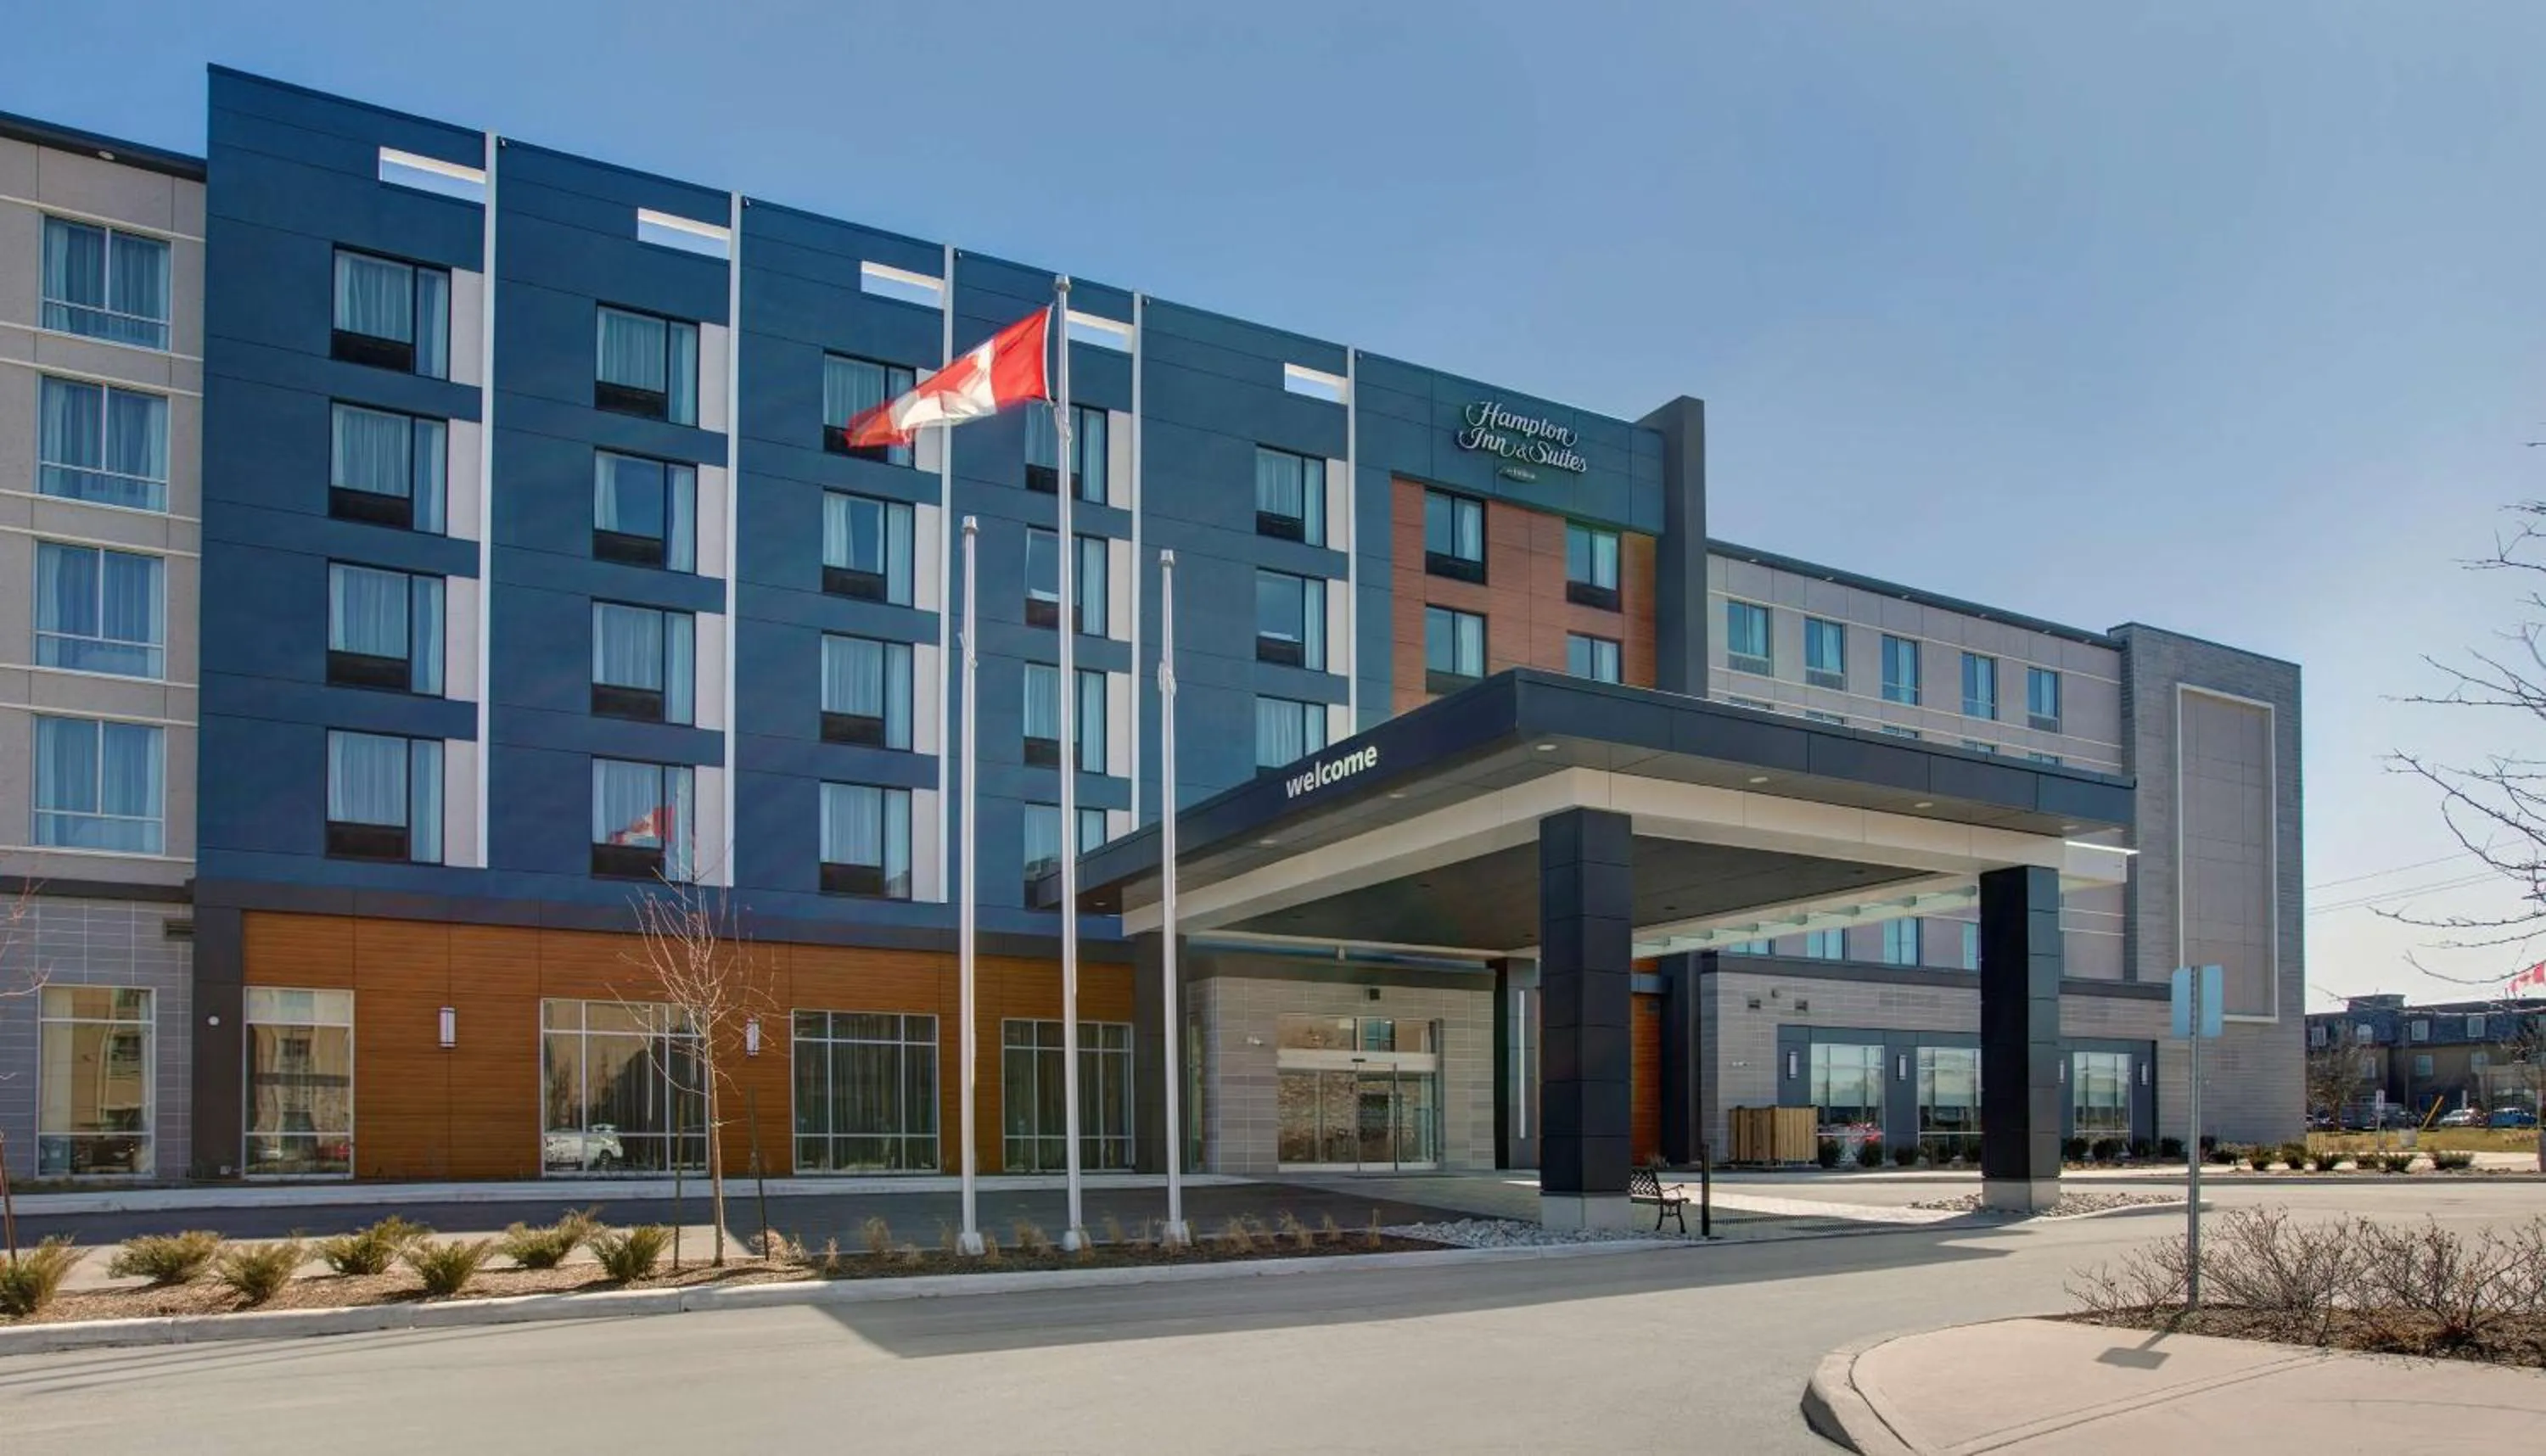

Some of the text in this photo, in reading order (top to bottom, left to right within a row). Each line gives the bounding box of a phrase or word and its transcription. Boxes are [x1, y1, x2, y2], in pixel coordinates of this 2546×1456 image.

[1466, 401, 1578, 447] Hampton
[1459, 427, 1587, 473] Inn & Suites
[1286, 746, 1377, 798] welcome
